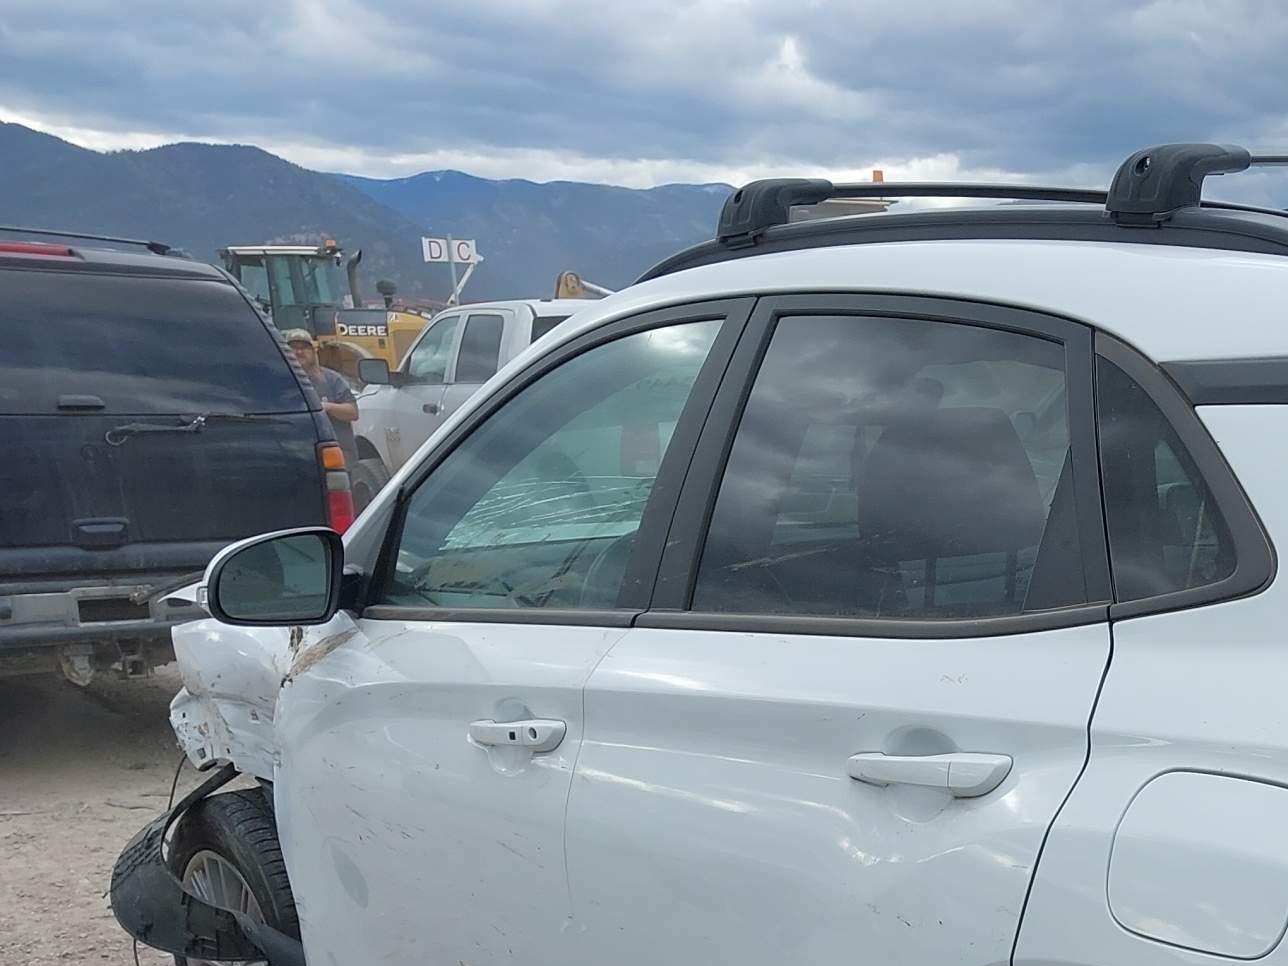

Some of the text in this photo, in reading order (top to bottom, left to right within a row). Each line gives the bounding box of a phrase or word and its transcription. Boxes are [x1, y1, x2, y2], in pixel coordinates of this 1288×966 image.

[428, 240, 472, 261] D C
[337, 323, 387, 336] DEERE
